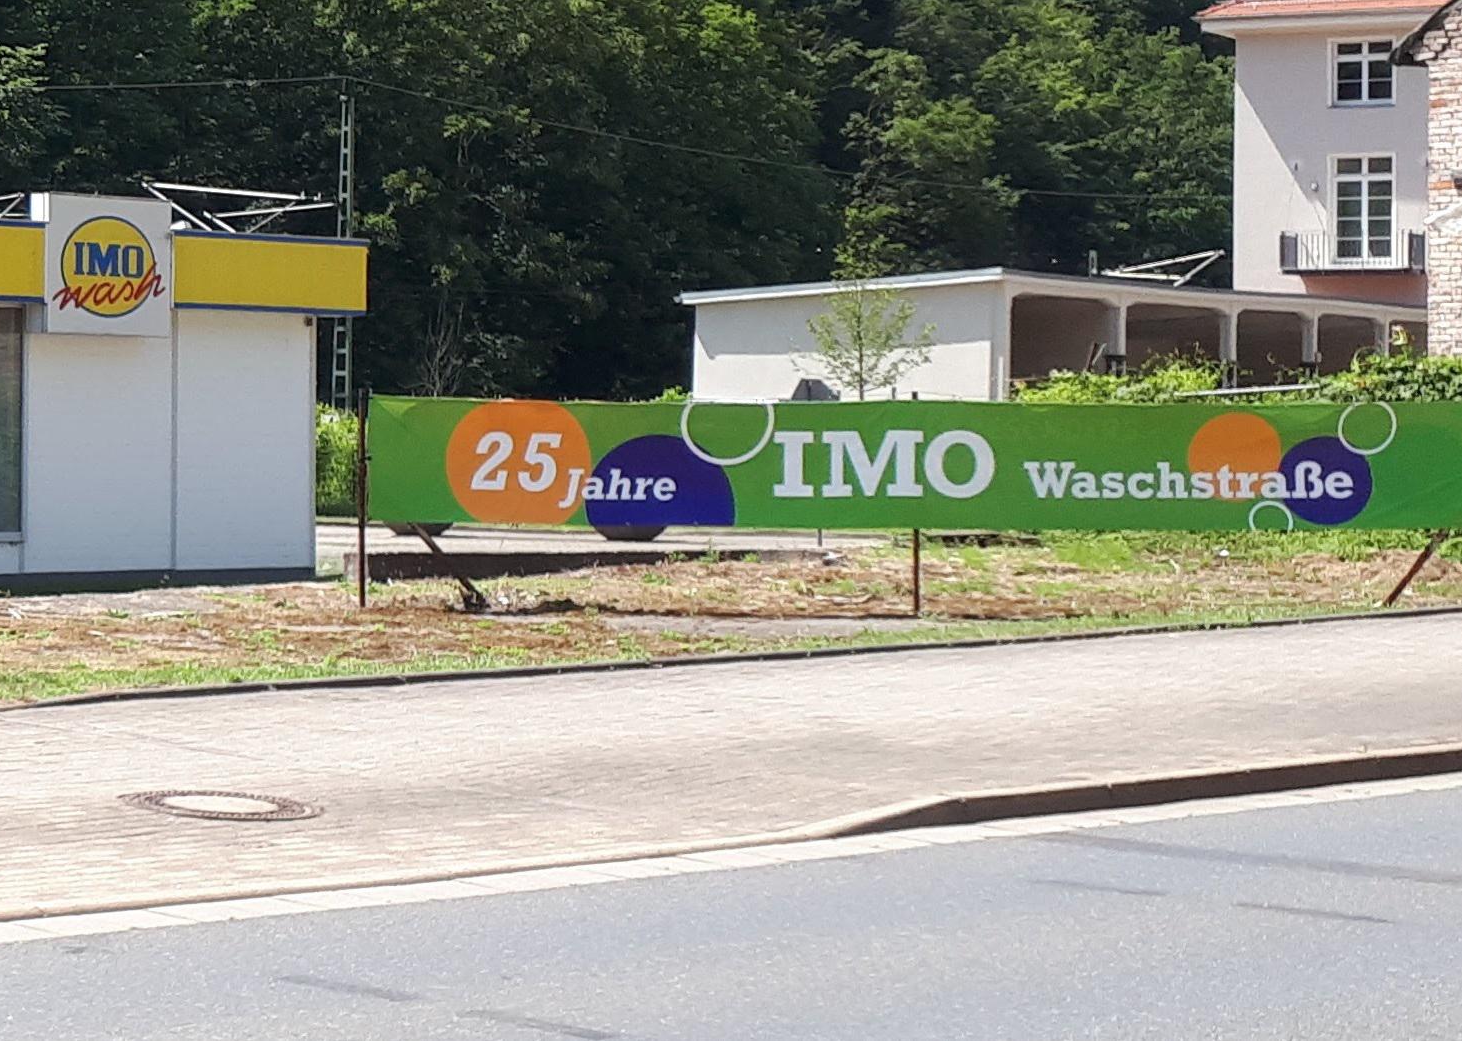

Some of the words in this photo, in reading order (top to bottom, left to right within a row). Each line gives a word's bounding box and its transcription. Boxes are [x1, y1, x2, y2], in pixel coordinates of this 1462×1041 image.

[73, 242, 144, 278] IMO
[52, 261, 165, 310] wash
[470, 431, 563, 493] 25
[558, 468, 677, 509] Jahre
[774, 430, 995, 499] IMO
[1023, 461, 1354, 500] Waschstraße
